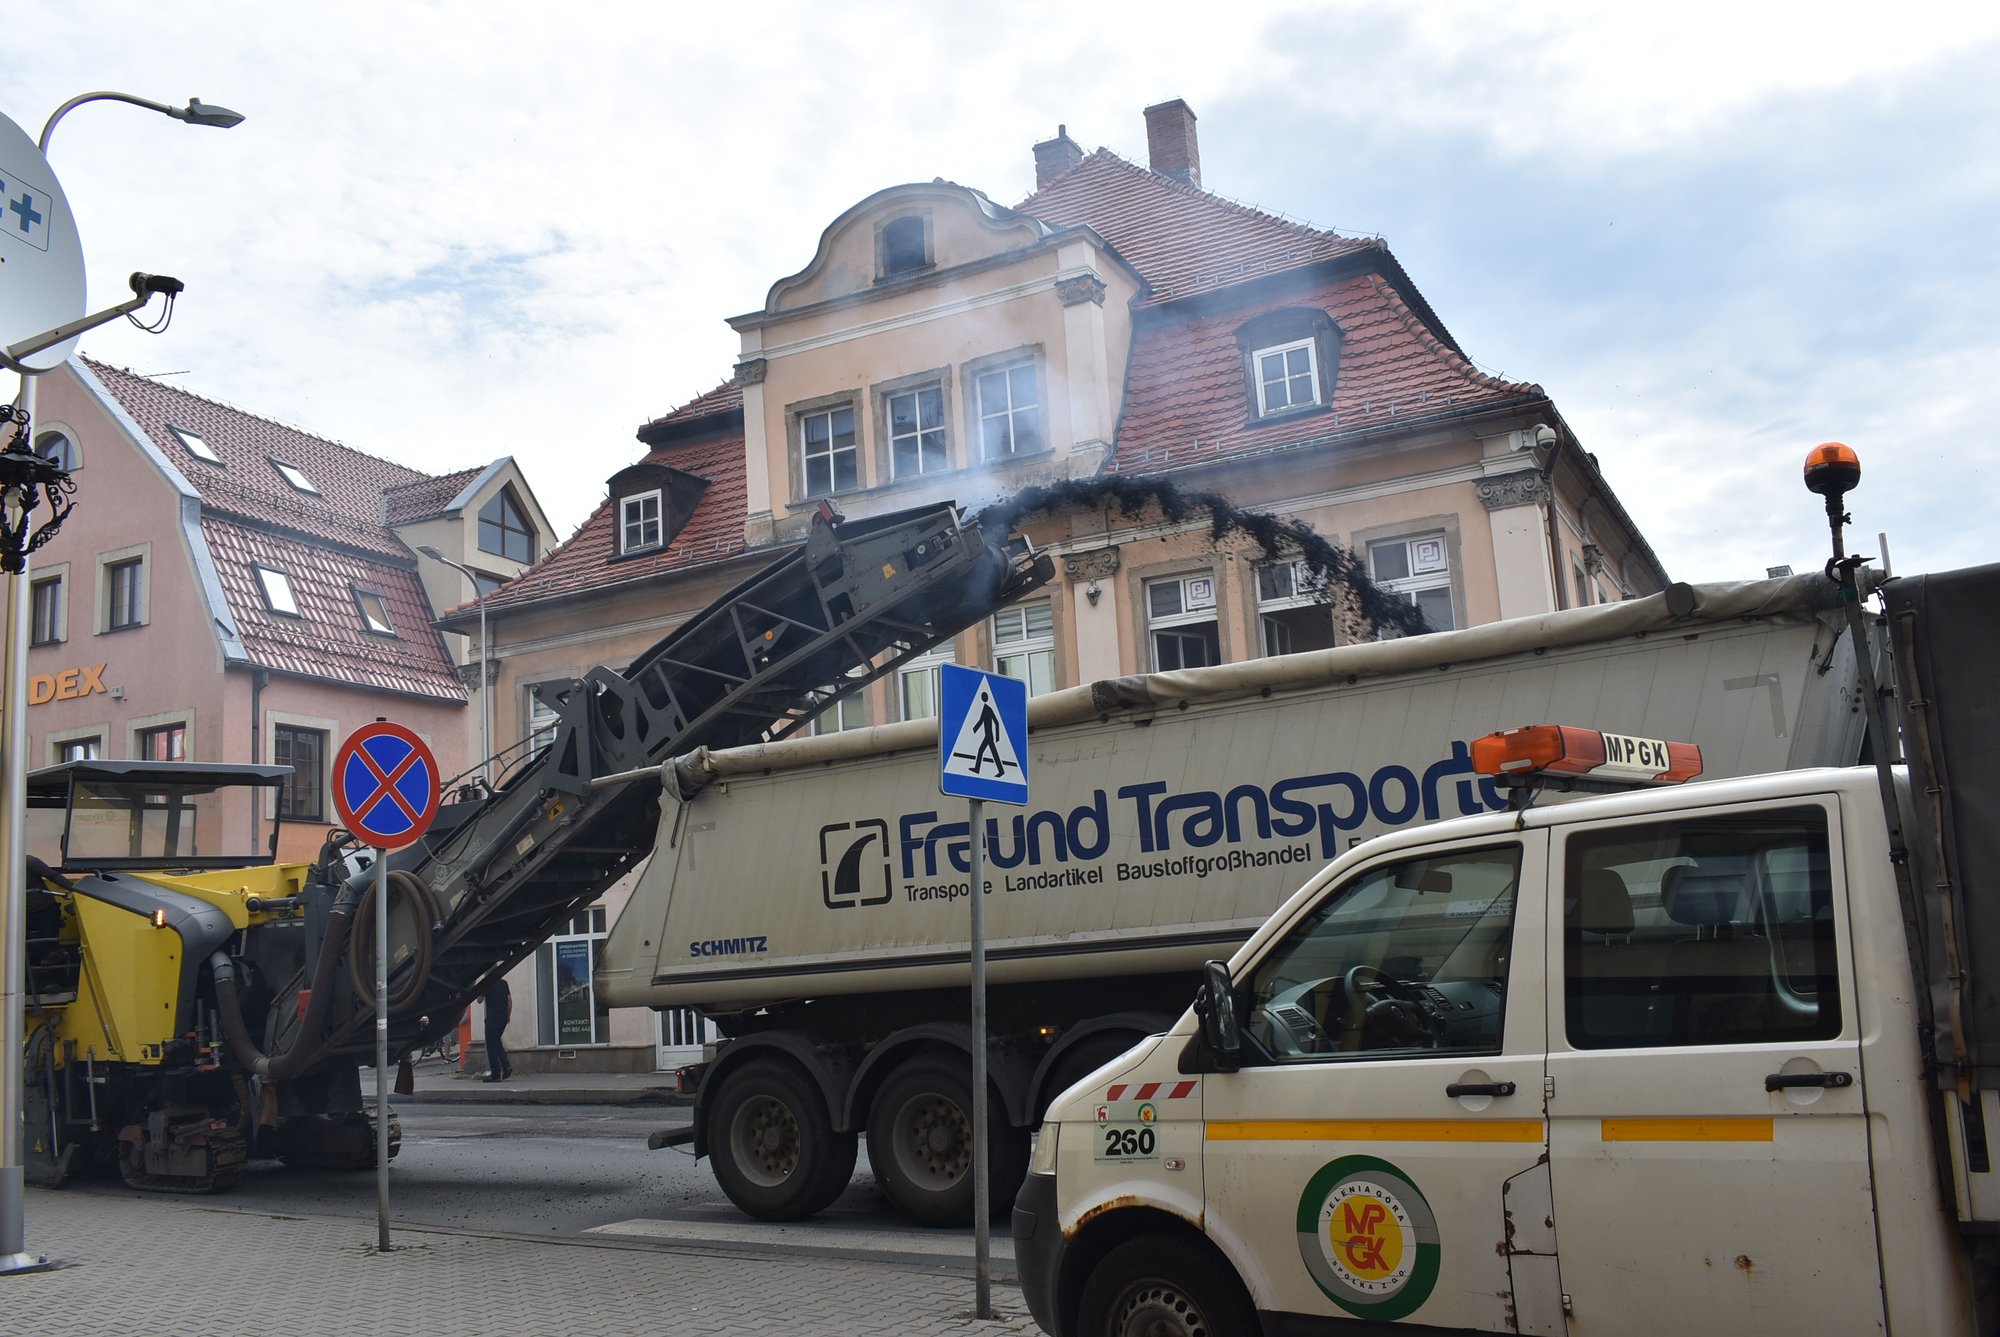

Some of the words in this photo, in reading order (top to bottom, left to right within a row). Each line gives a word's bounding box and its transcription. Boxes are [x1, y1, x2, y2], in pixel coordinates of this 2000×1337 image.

[28, 662, 107, 706] DEX
[1605, 735, 1667, 768] MPGK
[899, 789, 1111, 879] Freund
[904, 880, 993, 902] Transpoe
[1005, 866, 1104, 892] Landartikel
[1116, 843, 1312, 881] Baustoffgroßhandel
[690, 935, 768, 957] SCHMITZ
[1105, 1128, 1156, 1156] 260
[1326, 1185, 1371, 1218] JELENIA
